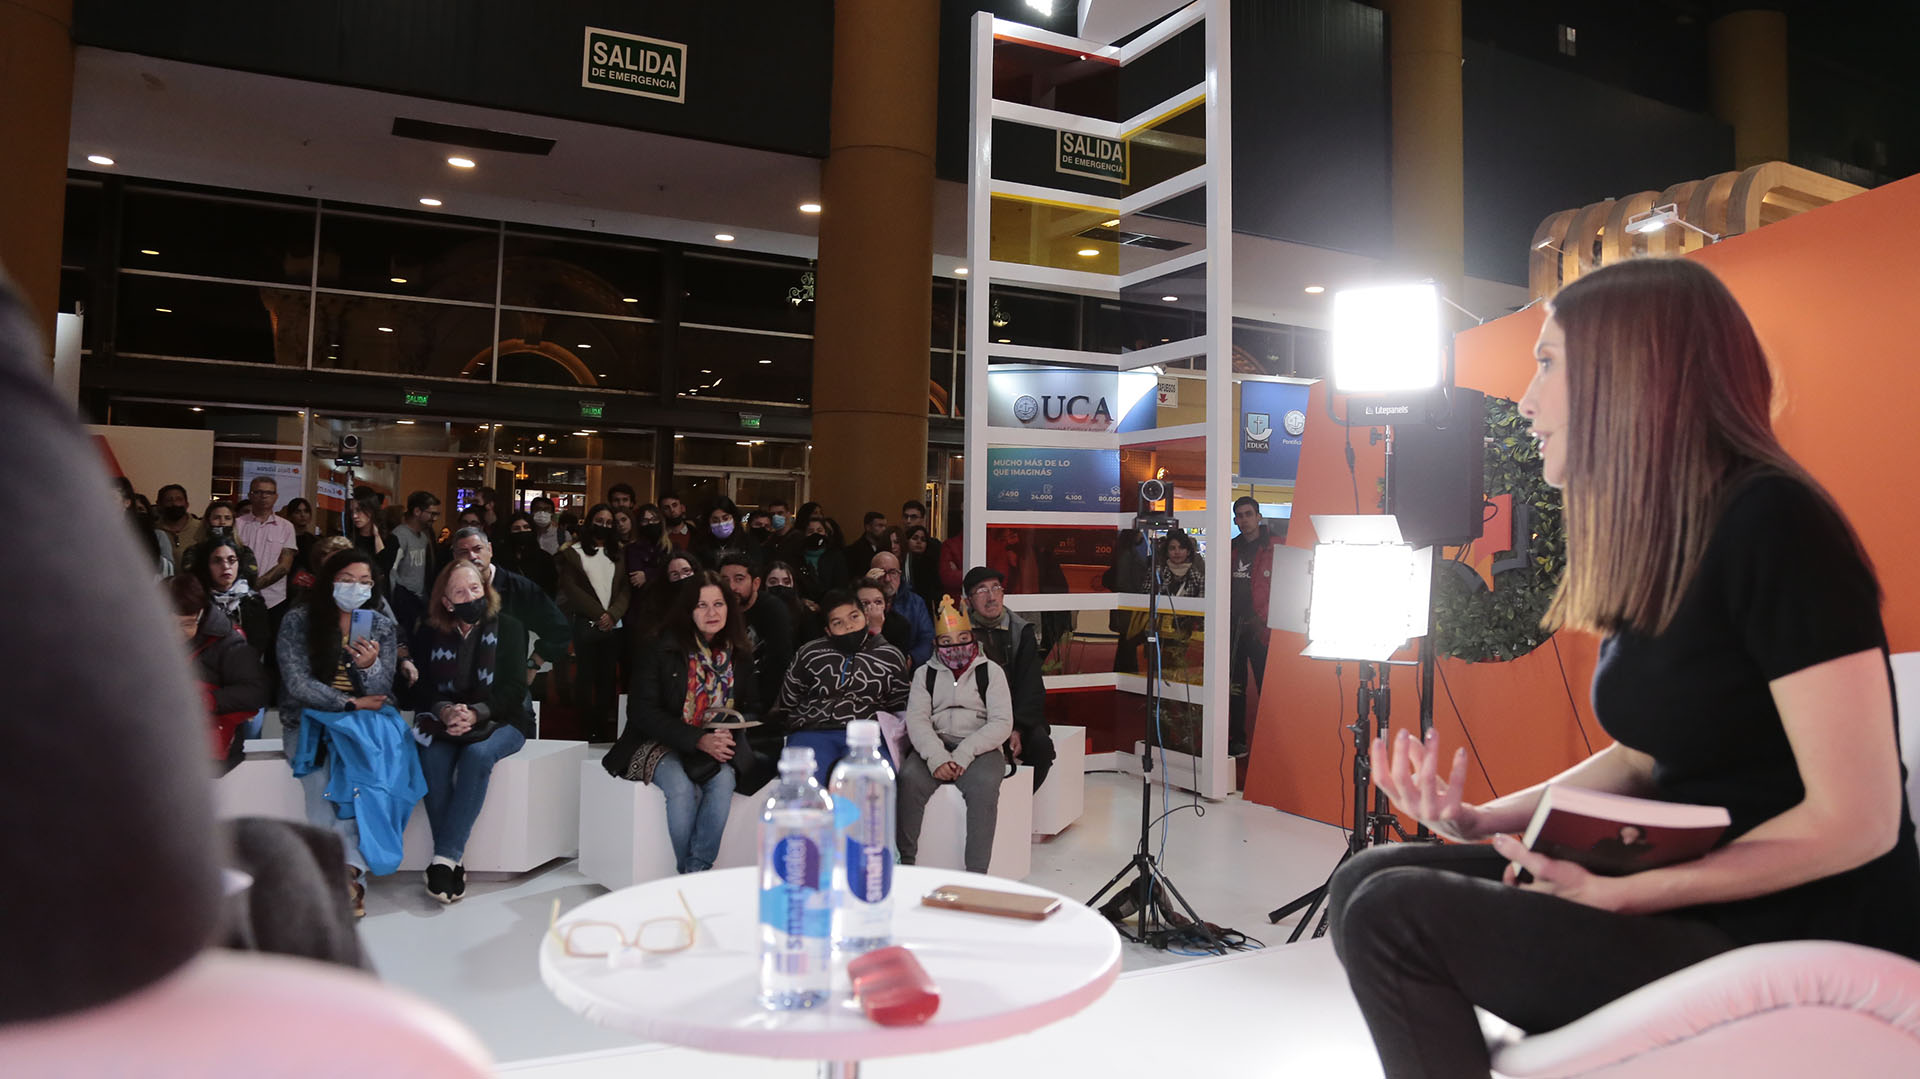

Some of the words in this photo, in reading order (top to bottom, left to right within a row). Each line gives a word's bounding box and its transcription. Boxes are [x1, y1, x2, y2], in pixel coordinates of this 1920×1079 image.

[593, 41, 676, 77] SALIDA
[591, 67, 606, 77] DE
[608, 70, 676, 90] EMERGENCIA
[1063, 133, 1123, 162] SALIDA
[1062, 155, 1073, 163] DE
[1074, 157, 1124, 173] EMERGENCIA
[1158, 383, 1176, 393] AFUEGOS
[1041, 395, 1114, 423] UCA
[1375, 406, 1409, 416] Litepanels
[1247, 442, 1269, 450] EDUCA
[1024, 458, 1042, 466] MÁS
[1045, 459, 1057, 467] DE
[1058, 460, 1071, 468] LO
[993, 468, 1009, 477] QUE
[1011, 467, 1052, 476] IMAGINÁS
[1095, 545, 1112, 554] 200
